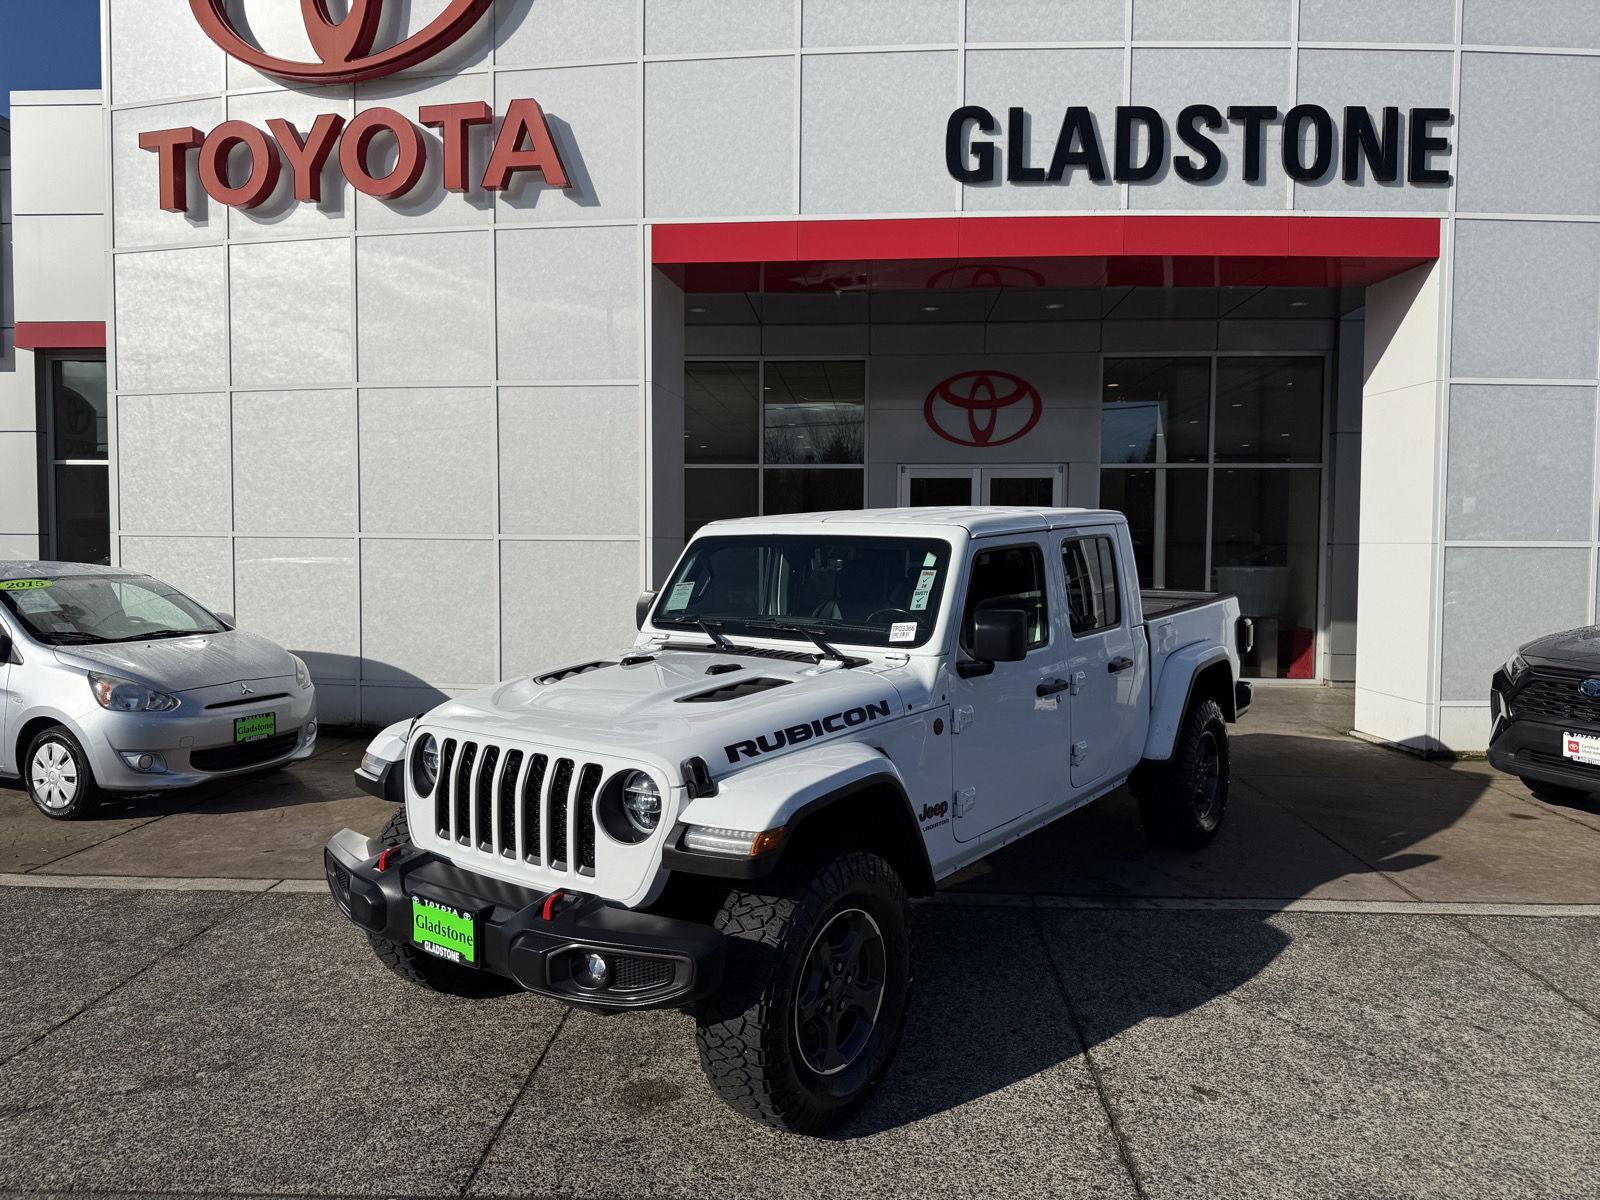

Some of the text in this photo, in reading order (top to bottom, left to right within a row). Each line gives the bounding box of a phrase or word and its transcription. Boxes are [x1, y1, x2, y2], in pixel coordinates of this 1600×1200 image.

[945, 103, 1451, 185] GLADSTONE
[139, 98, 572, 213] TOYOTA
[6, 580, 44, 589] 2015
[237, 723, 273, 735] Gladstone
[724, 700, 891, 764] RUBICON
[919, 801, 948, 822] Jeep
[424, 899, 458, 916] TOYOTA
[416, 914, 473, 946] Gladstone
[424, 941, 460, 962] GLADSTONE
